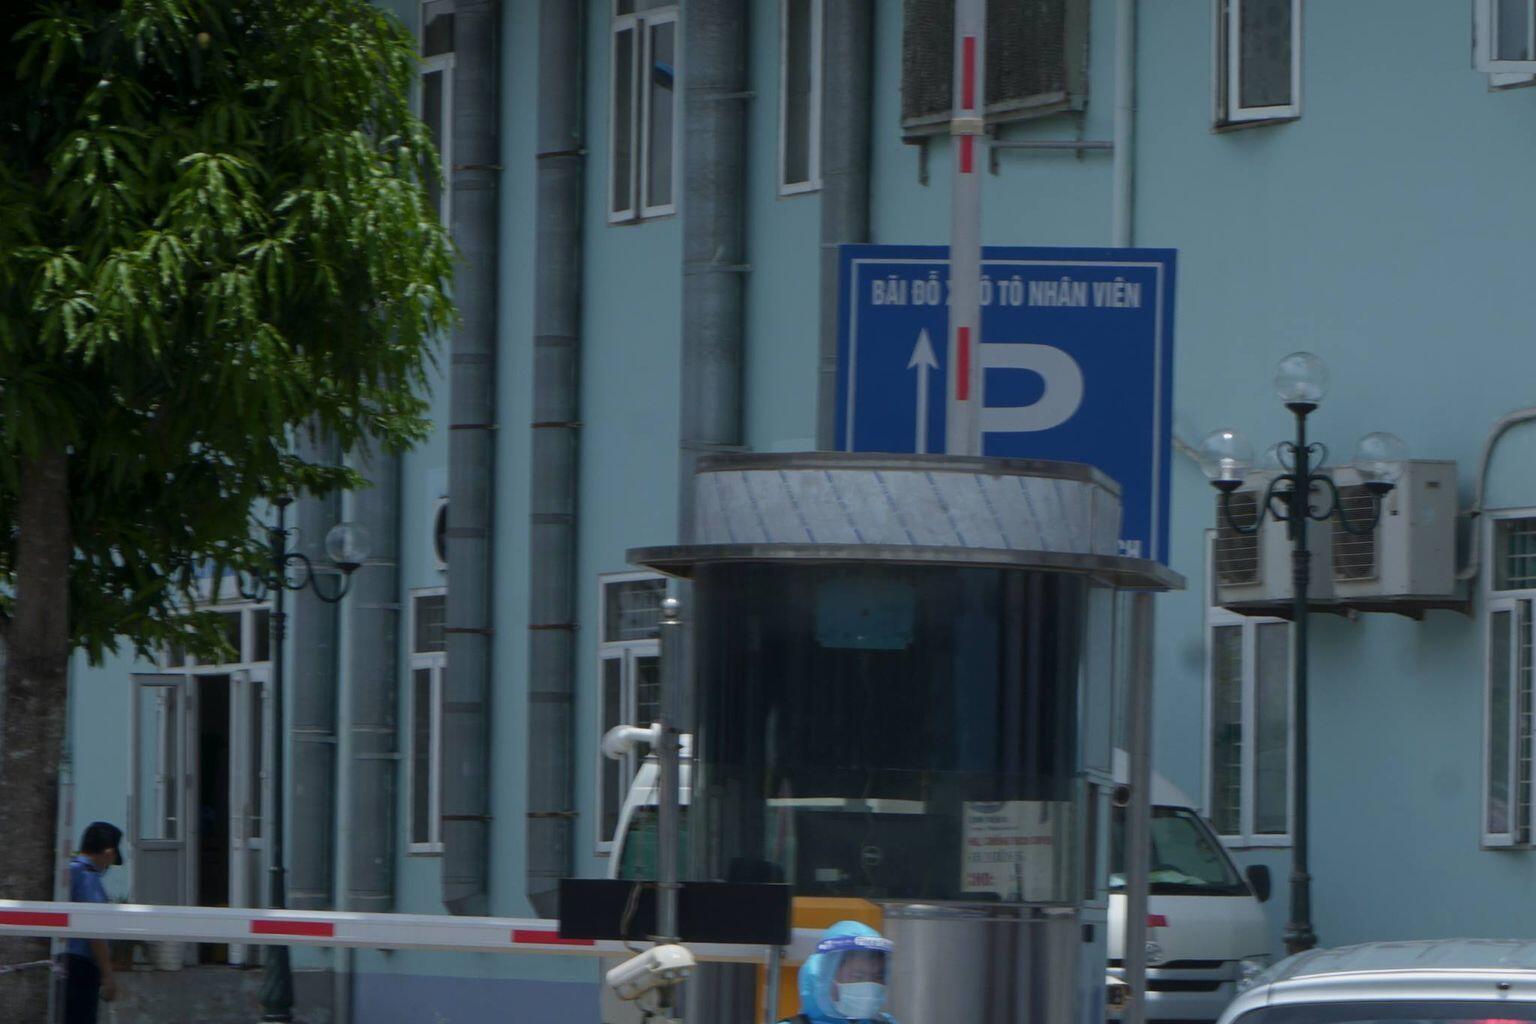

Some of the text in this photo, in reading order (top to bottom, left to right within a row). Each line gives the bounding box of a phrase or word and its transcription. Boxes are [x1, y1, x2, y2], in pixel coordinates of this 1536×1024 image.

[872, 275, 907, 305] BÃI
[911, 271, 940, 305] ĐỖ
[998, 275, 1025, 306] TÔ
[1028, 276, 1088, 307] NHÂN
[1093, 277, 1142, 308] VIÊN
